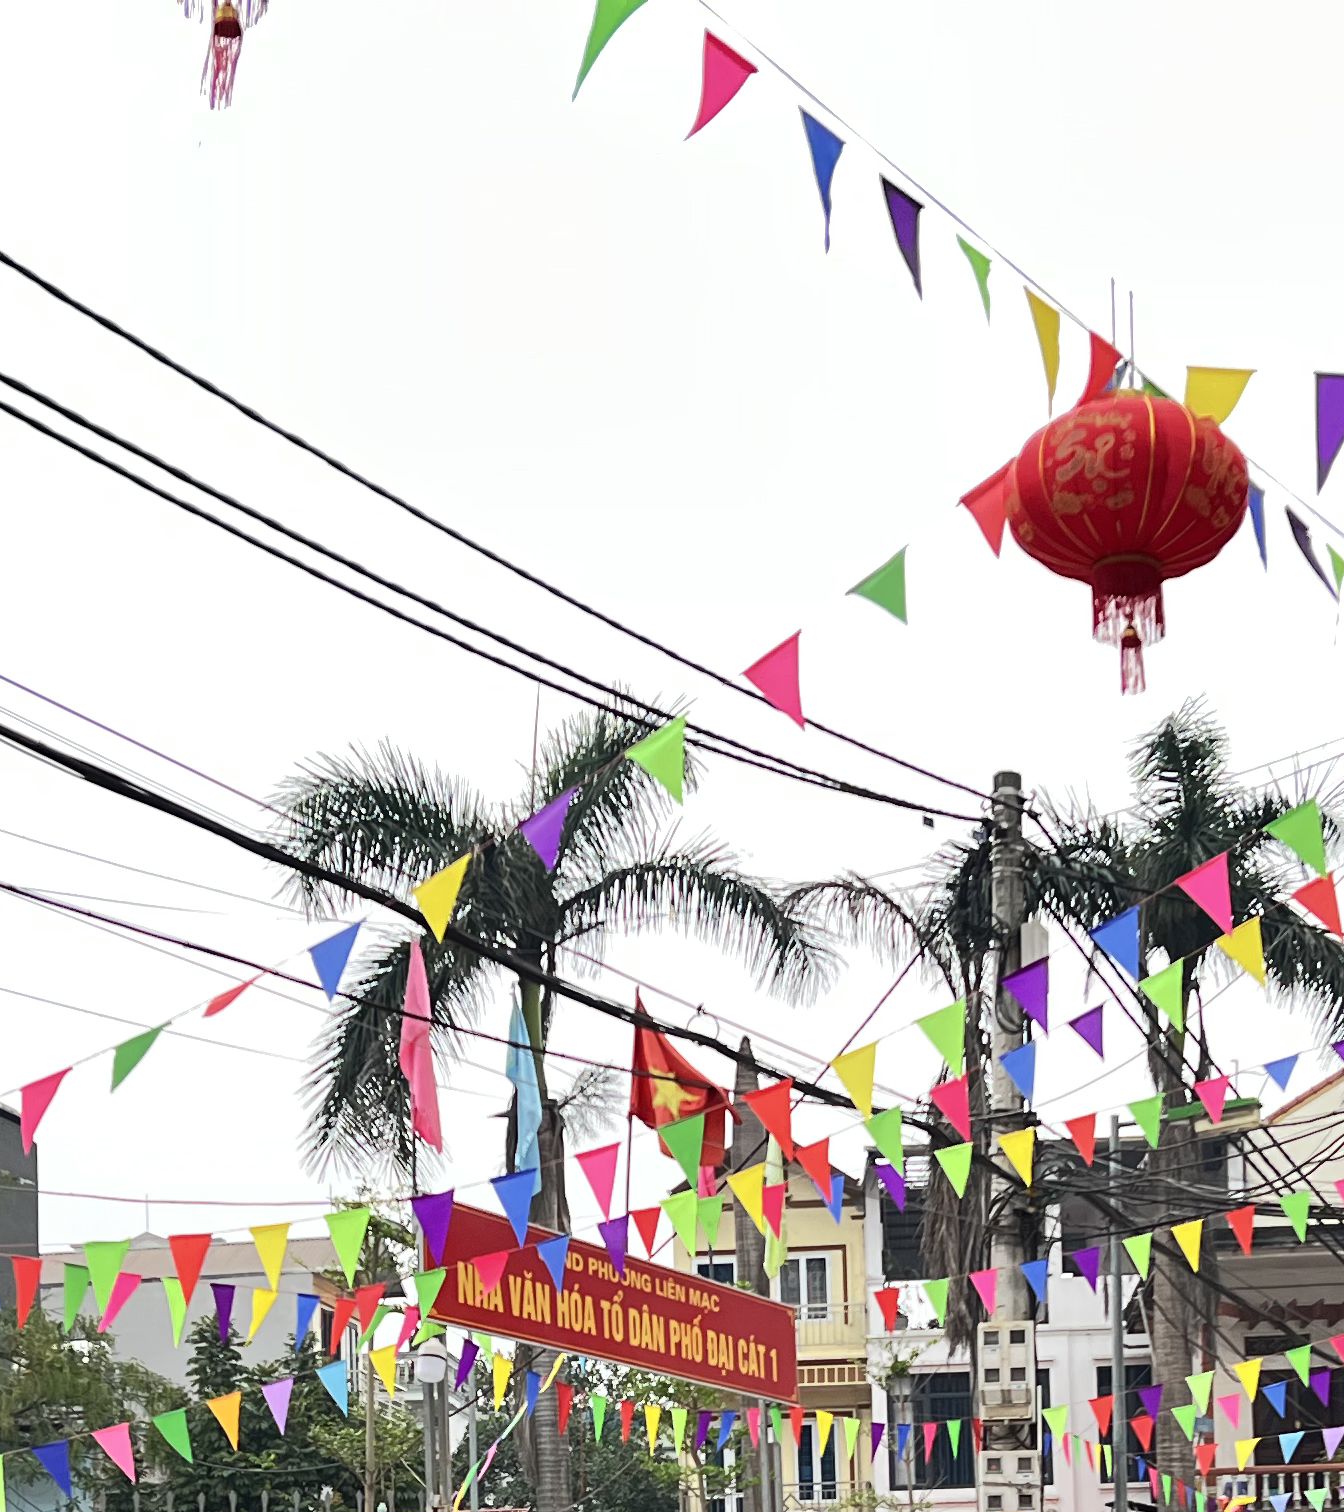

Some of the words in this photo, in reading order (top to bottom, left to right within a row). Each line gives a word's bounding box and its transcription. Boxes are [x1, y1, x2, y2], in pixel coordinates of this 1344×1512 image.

[508, 1270, 551, 1325] VĂN
[557, 1284, 597, 1336] HÓA
[600, 1290, 624, 1343] TỔ
[628, 1304, 666, 1354] DÂN
[669, 1314, 703, 1363] PHỐ
[706, 1329, 734, 1376] ĐẠI
[738, 1335, 766, 1379] CÁT
[770, 1348, 778, 1382] 1
[655, 1277, 686, 1303] LIÊN
[689, 1288, 720, 1314] MẠC
